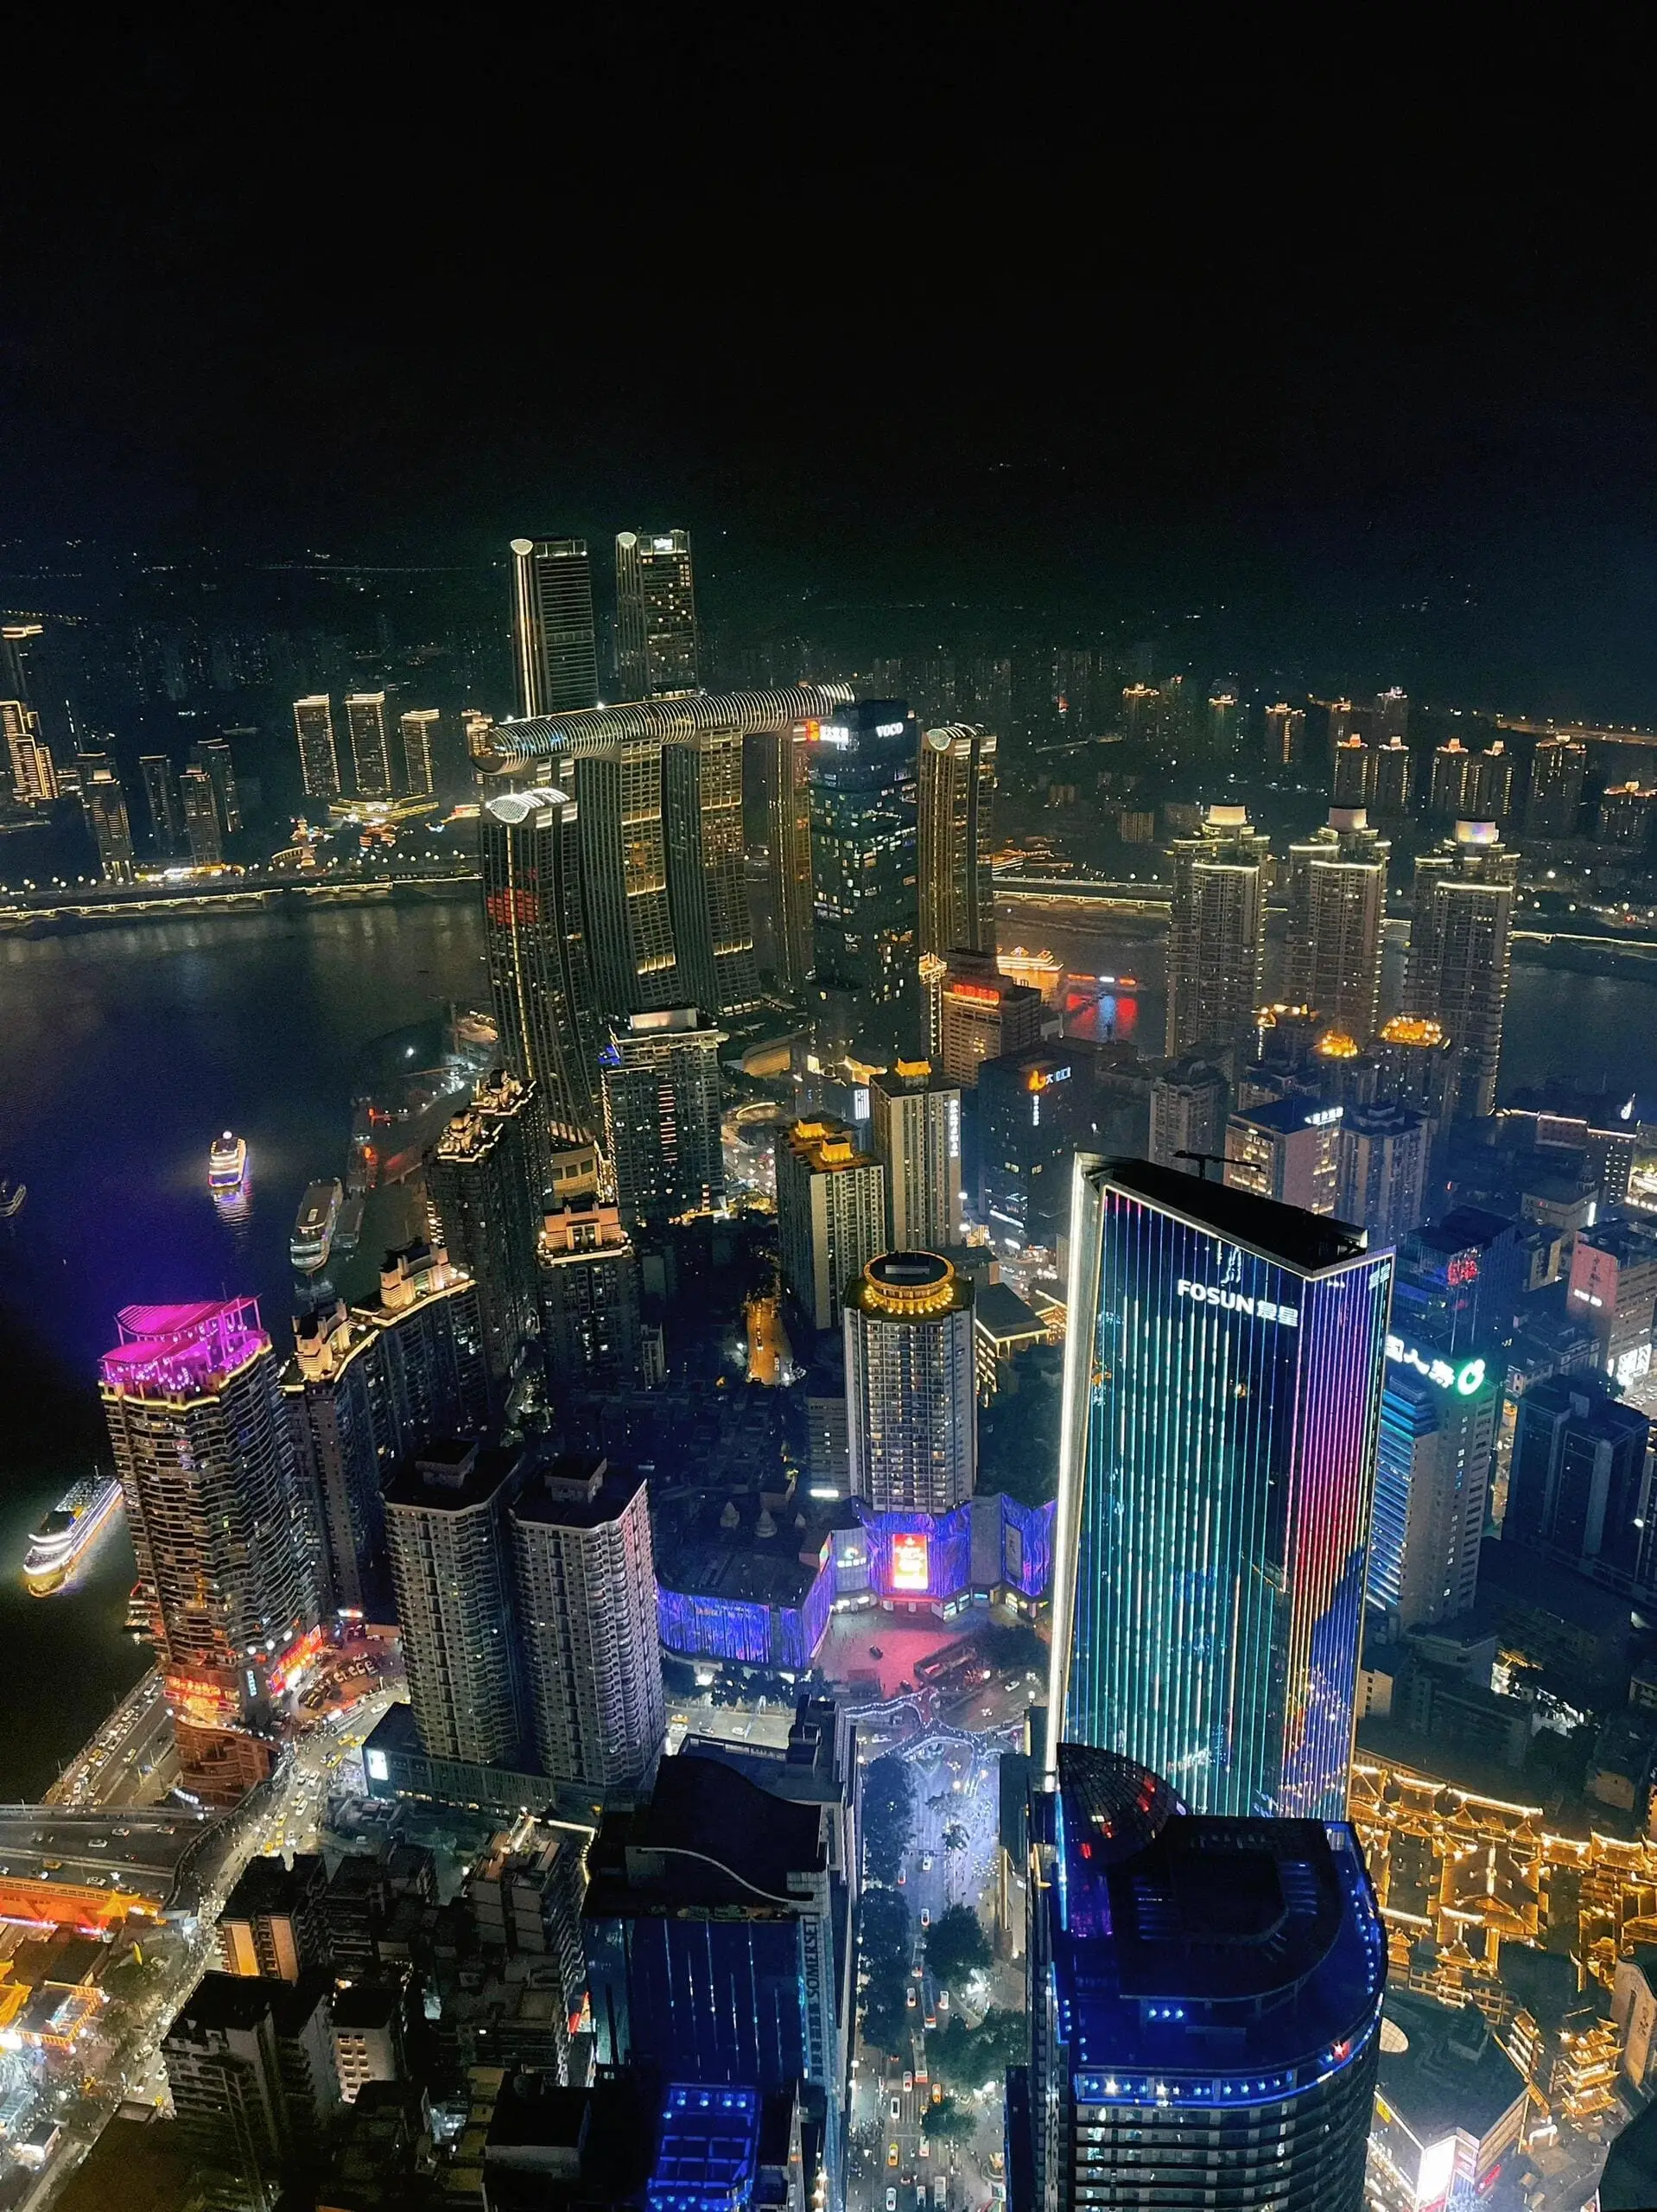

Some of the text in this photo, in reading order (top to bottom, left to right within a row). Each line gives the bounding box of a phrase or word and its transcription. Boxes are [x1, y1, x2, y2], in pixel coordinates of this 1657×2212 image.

[1177, 1279, 1298, 1327] FOSUN 复星
[803, 1919, 821, 1999] SOMERSET
